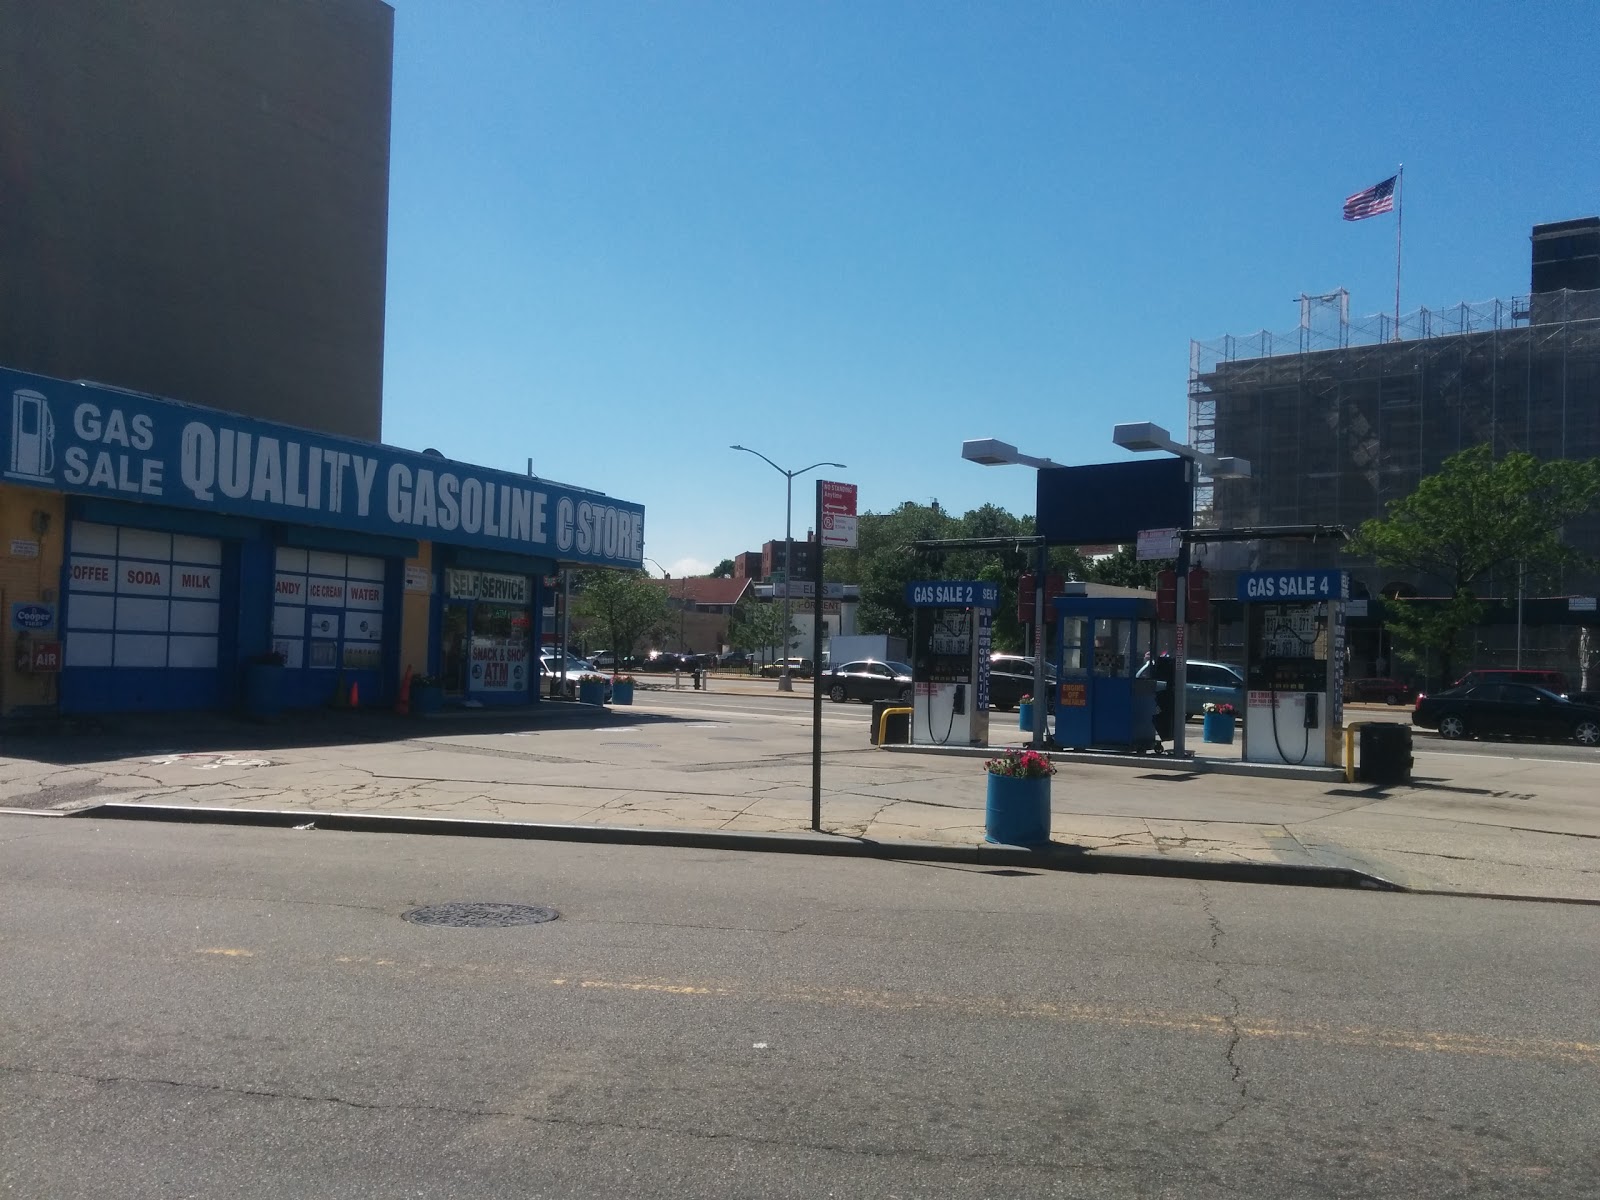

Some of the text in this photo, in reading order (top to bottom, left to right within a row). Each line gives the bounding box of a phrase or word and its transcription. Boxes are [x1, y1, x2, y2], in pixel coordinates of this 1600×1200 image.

[74, 403, 154, 451] GAS
[64, 447, 164, 496] SALE
[181, 421, 643, 562] QUALITY GASOLINE C STORE
[127, 570, 161, 586] SODA
[182, 574, 211, 589] MILK
[309, 584, 343, 598] ICE CREAM
[453, 573, 479, 597] SELF
[482, 575, 524, 601] SERVICE
[803, 584, 829, 595] ELS
[982, 588, 998, 600] SELF
[1247, 577, 1275, 597] GAS
[1278, 576, 1316, 596] SALE
[1319, 576, 1329, 595] 4
[350, 587, 379, 602] WATER
[914, 586, 973, 603] GAS SALE 2
[17, 611, 51, 622] Cooper
[36, 653, 57, 666] AIR
[472, 645, 526, 662] SNACK & SHOP
[484, 662, 509, 681] ATM
[1062, 684, 1085, 692] ENGINE
[1067, 691, 1080, 699] OFF
